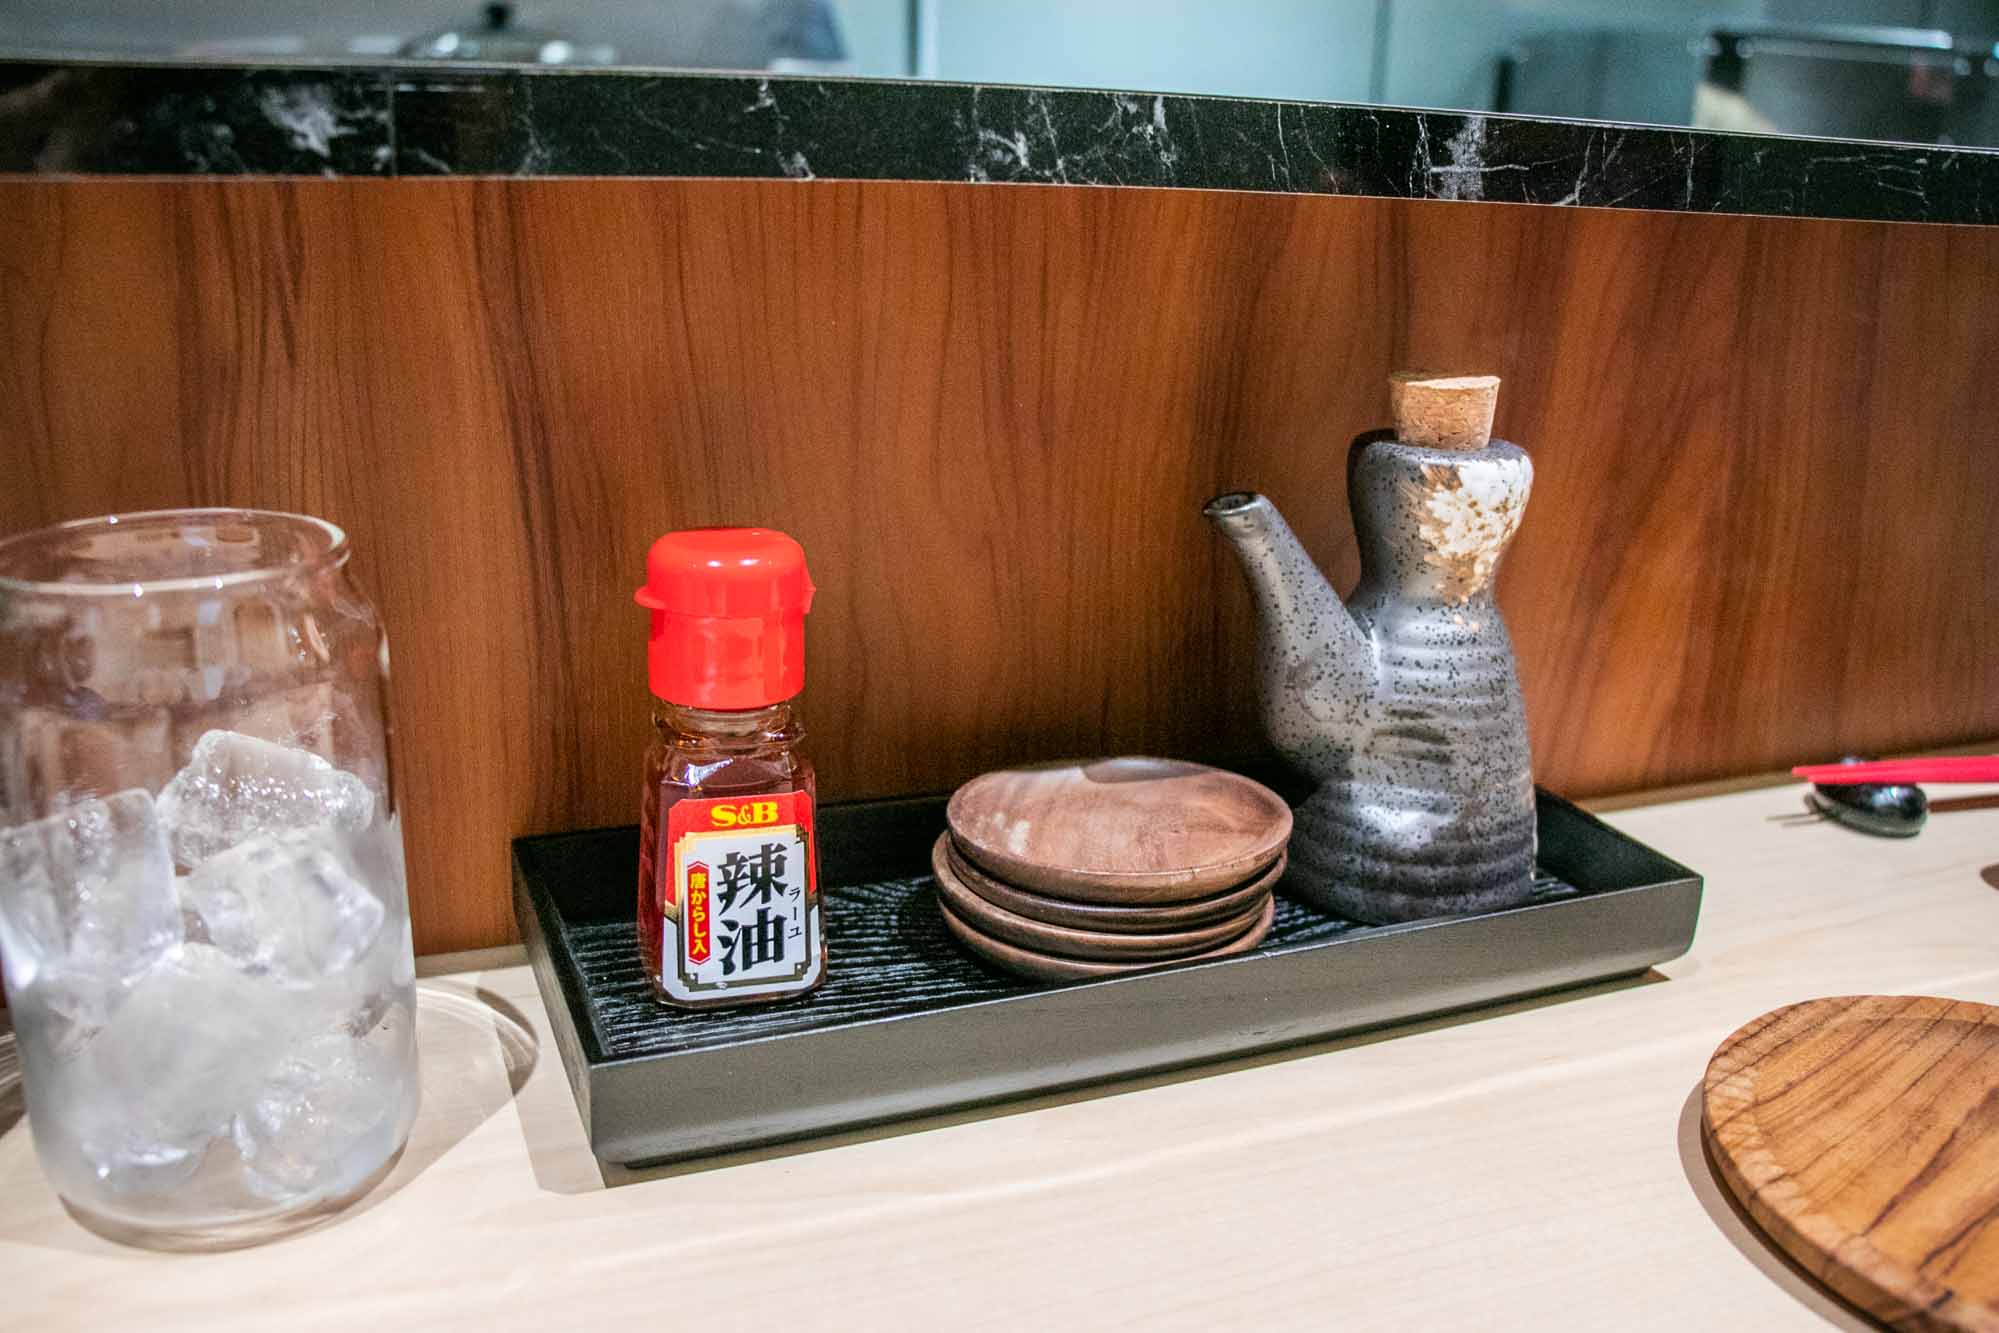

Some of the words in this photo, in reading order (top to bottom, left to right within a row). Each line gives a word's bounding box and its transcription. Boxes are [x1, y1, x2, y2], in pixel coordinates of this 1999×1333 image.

[711, 802, 779, 827] S&B
[690, 872, 707, 955] 唐からし入
[717, 843, 788, 976] 辣油
[788, 887, 803, 939] ラーユ
